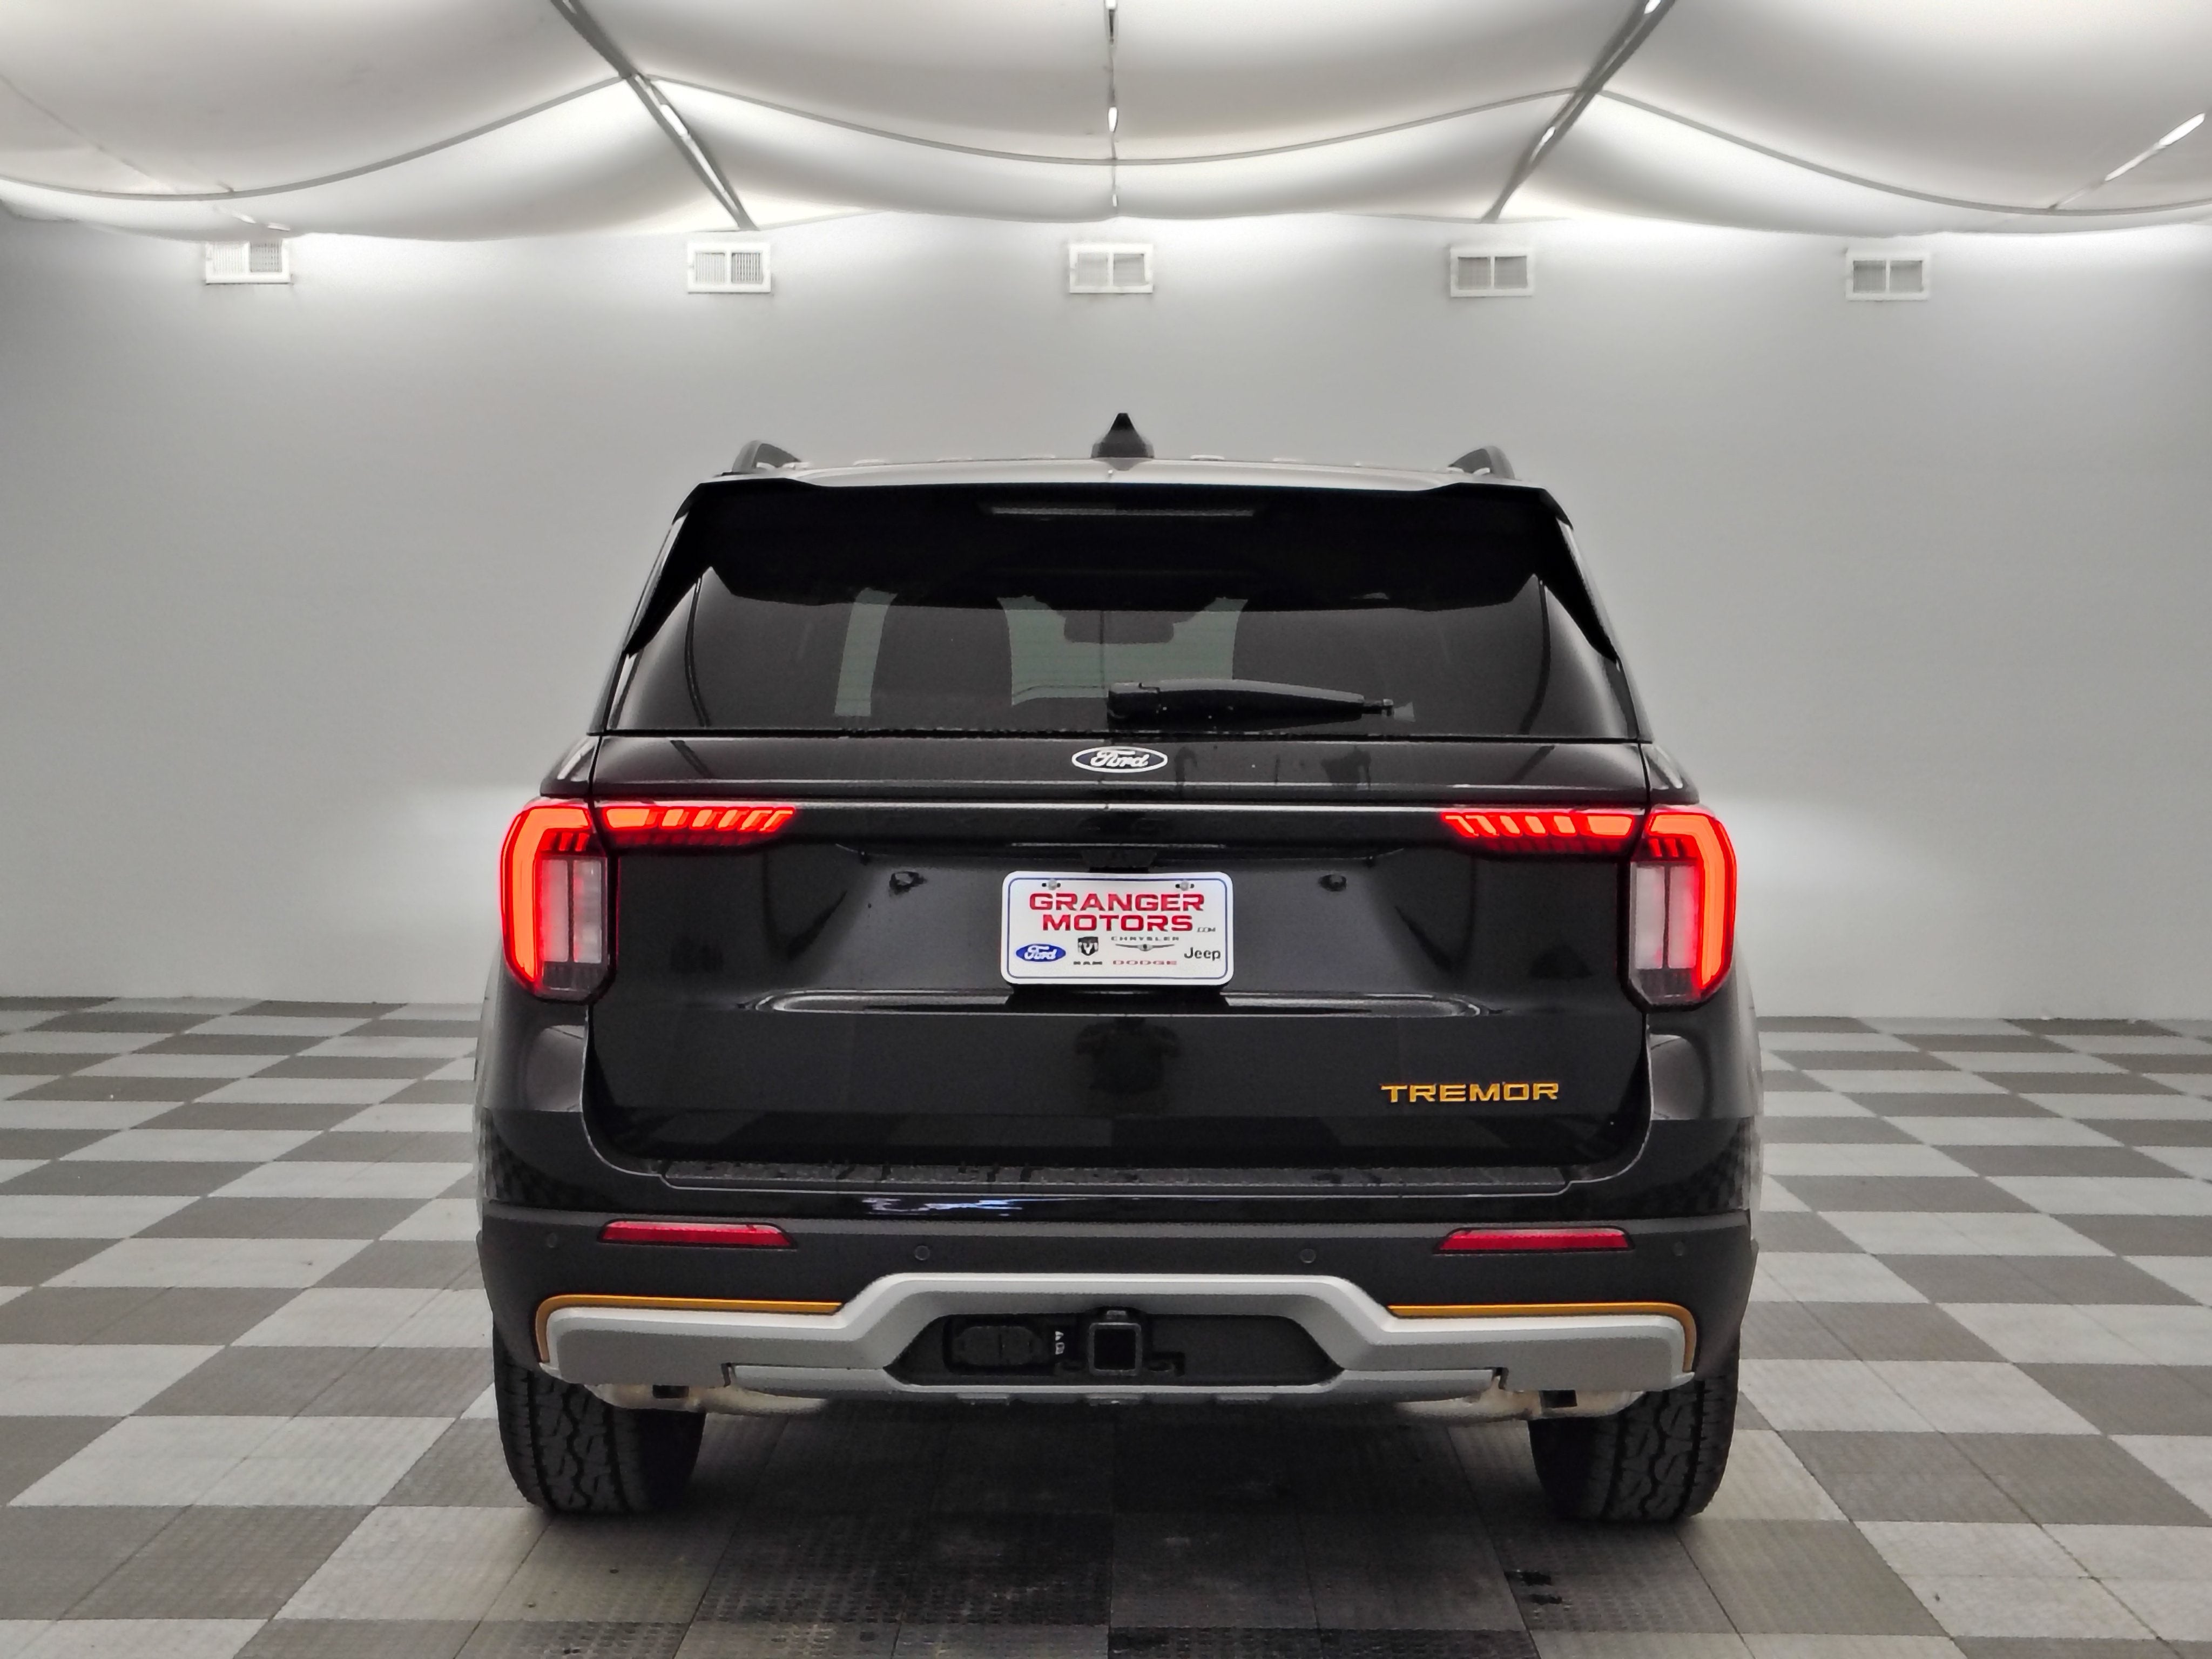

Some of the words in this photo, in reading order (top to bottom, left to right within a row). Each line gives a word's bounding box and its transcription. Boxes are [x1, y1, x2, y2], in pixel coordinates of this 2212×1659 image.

[1090, 750, 1150, 767] Ford
[1029, 893, 1205, 911] GRANGER
[1042, 914, 1193, 932] MOTORS
[1024, 945, 1057, 960] Ford
[1184, 946, 1222, 961] Jeep
[1380, 1082, 1559, 1103] TREMOR
